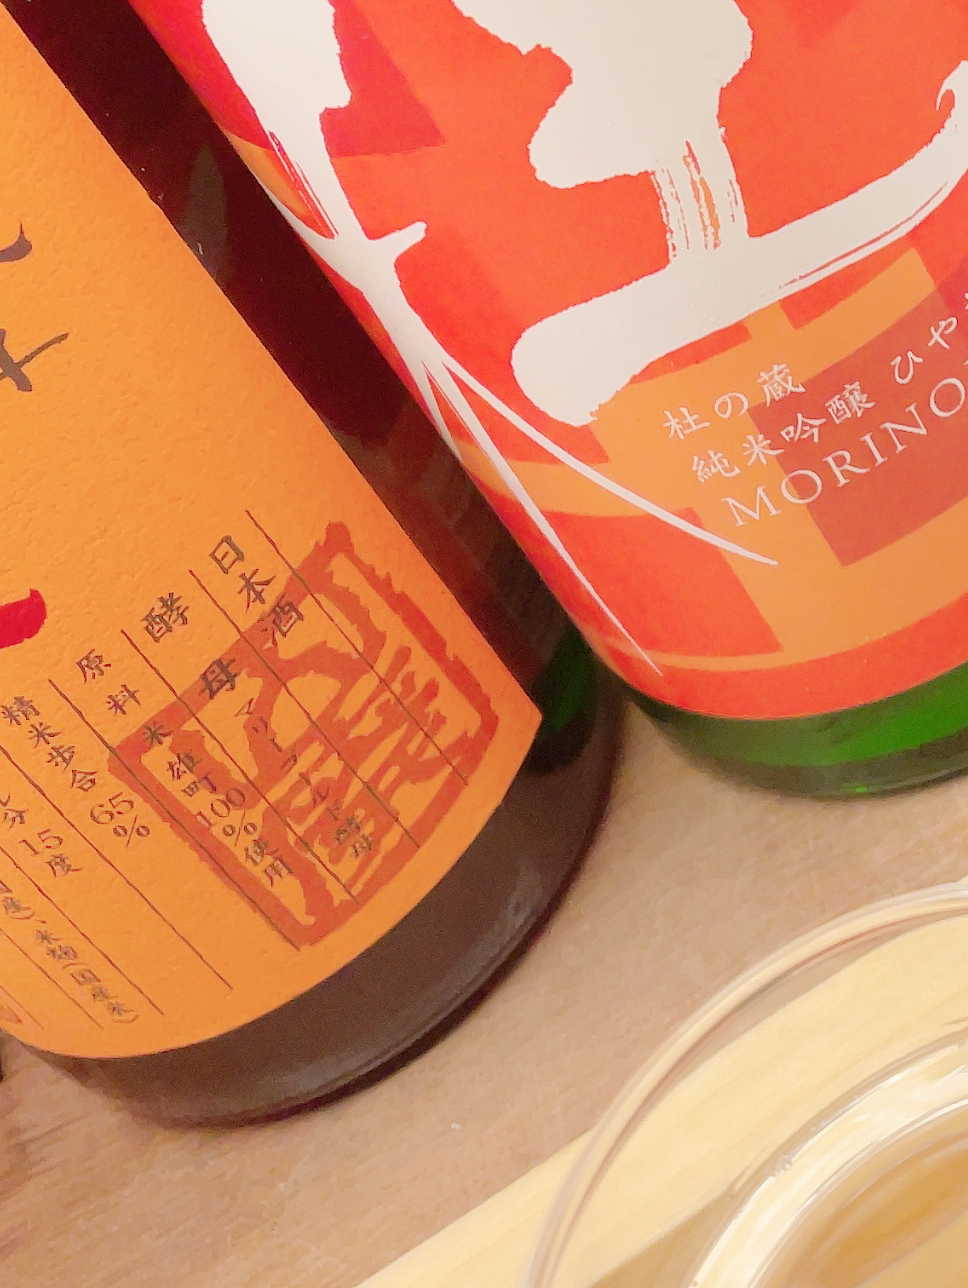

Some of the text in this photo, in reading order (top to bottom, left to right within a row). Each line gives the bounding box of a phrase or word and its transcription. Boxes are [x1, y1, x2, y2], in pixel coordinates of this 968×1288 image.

[662, 362, 806, 441] 杜の蔵
[691, 381, 876, 484] 純米吟醸
[209, 535, 305, 648] 日本酒
[18, 828, 84, 878] 15度
[89, 791, 151, 848] 65%
